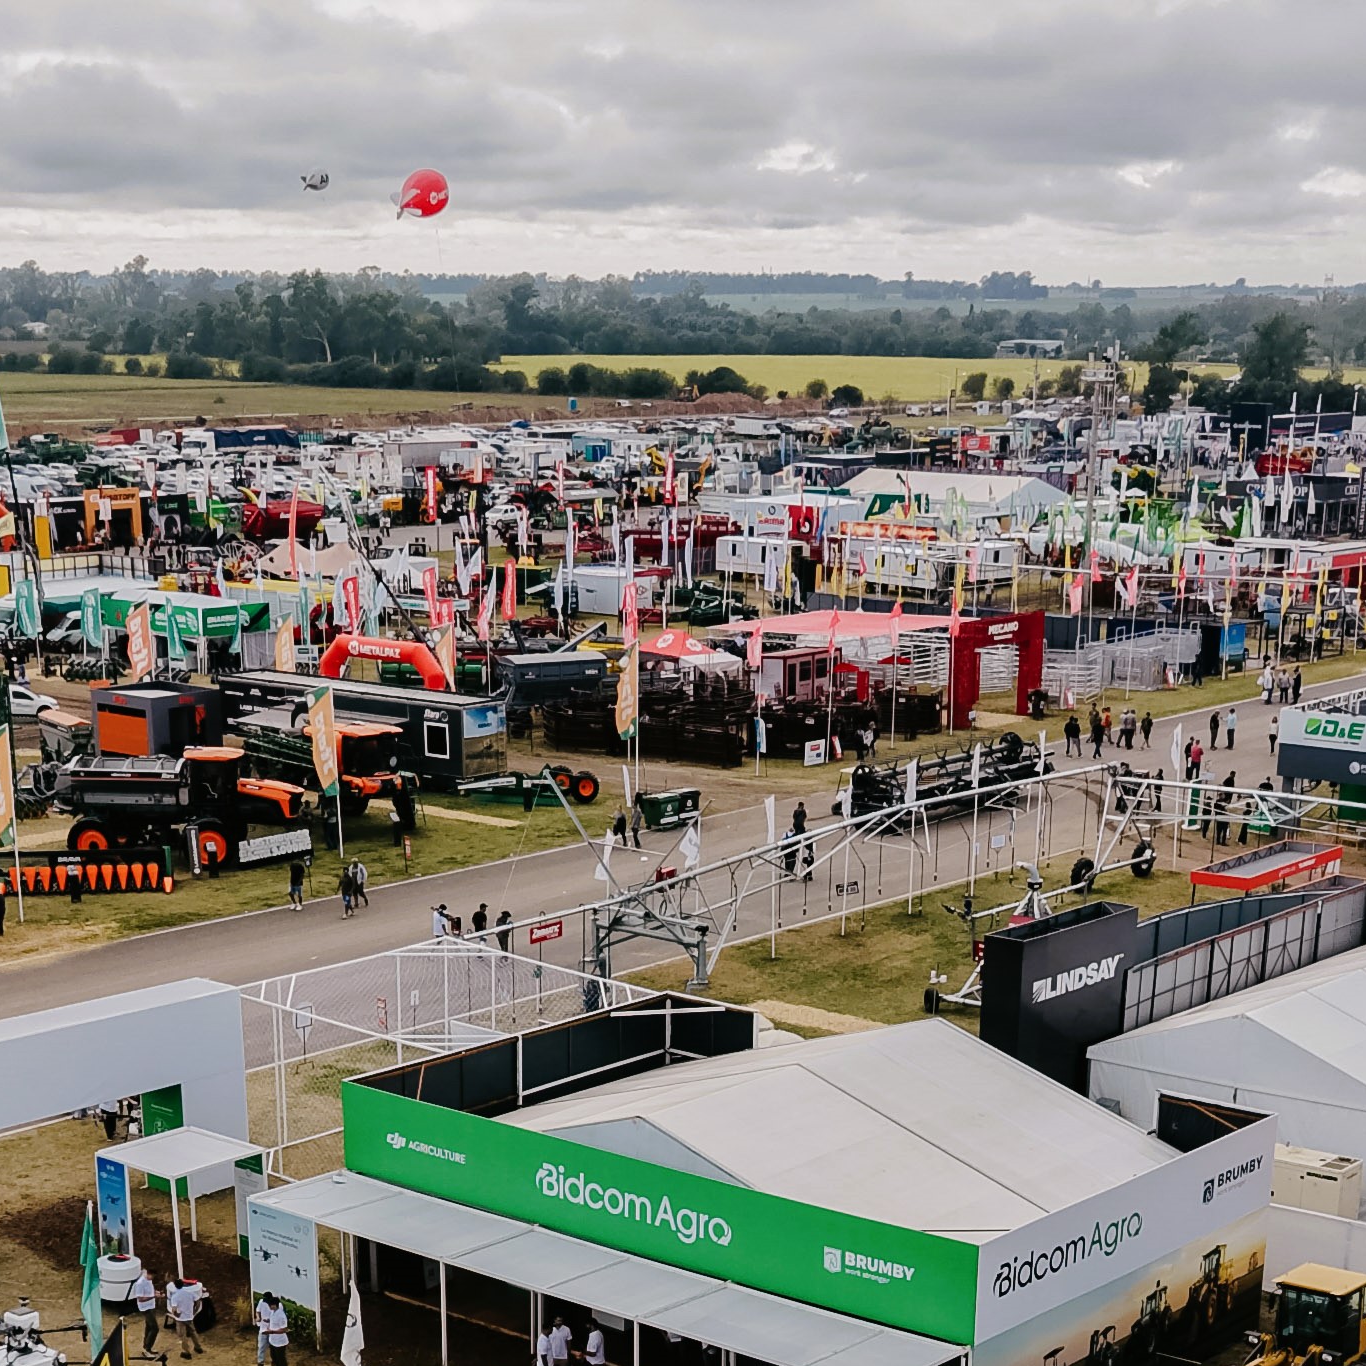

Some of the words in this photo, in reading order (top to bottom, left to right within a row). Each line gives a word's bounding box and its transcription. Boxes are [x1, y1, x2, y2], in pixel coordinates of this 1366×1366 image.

[359, 645, 401, 659] METALPAZ
[1321, 718, 1366, 742] D&E
[1044, 954, 1120, 998] LINDSAY
[408, 1139, 467, 1166] AGRICULTURE
[1217, 1155, 1264, 1188] BRUMBY
[845, 1250, 916, 1282] BRUMBY
[861, 1269, 891, 1285] stronger
